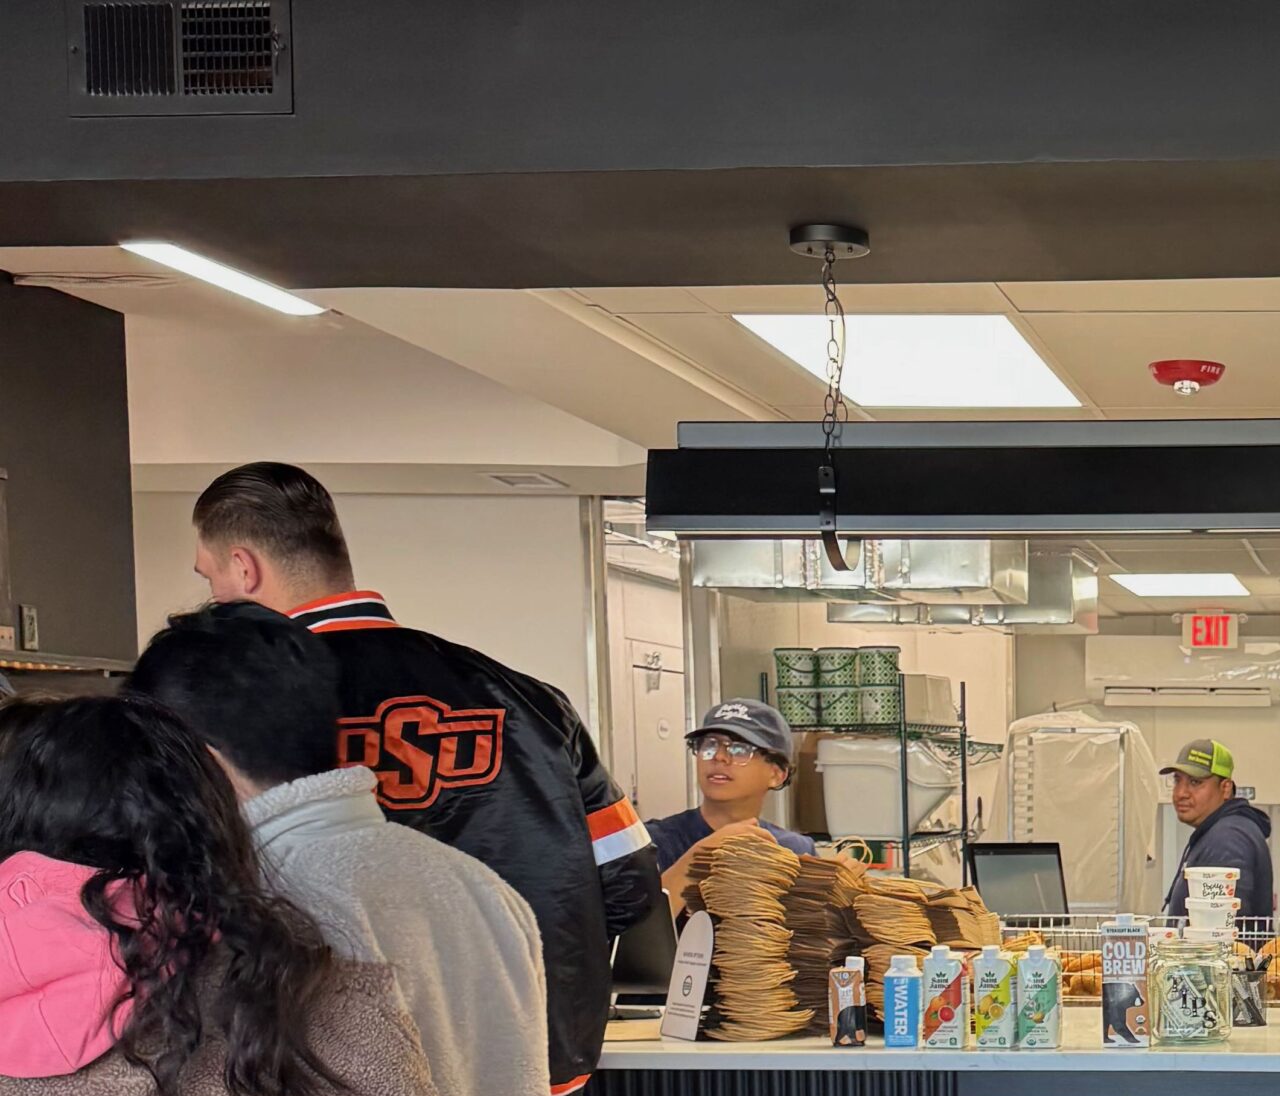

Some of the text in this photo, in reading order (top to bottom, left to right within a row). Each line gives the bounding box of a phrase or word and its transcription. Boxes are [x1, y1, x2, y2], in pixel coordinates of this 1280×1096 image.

[1191, 616, 1230, 647] EXIT
[1102, 941, 1147, 960] COLD
[1103, 959, 1146, 975] BREW
[894, 985, 909, 1036] WATER
[1167, 974, 1217, 1030] TIPS
